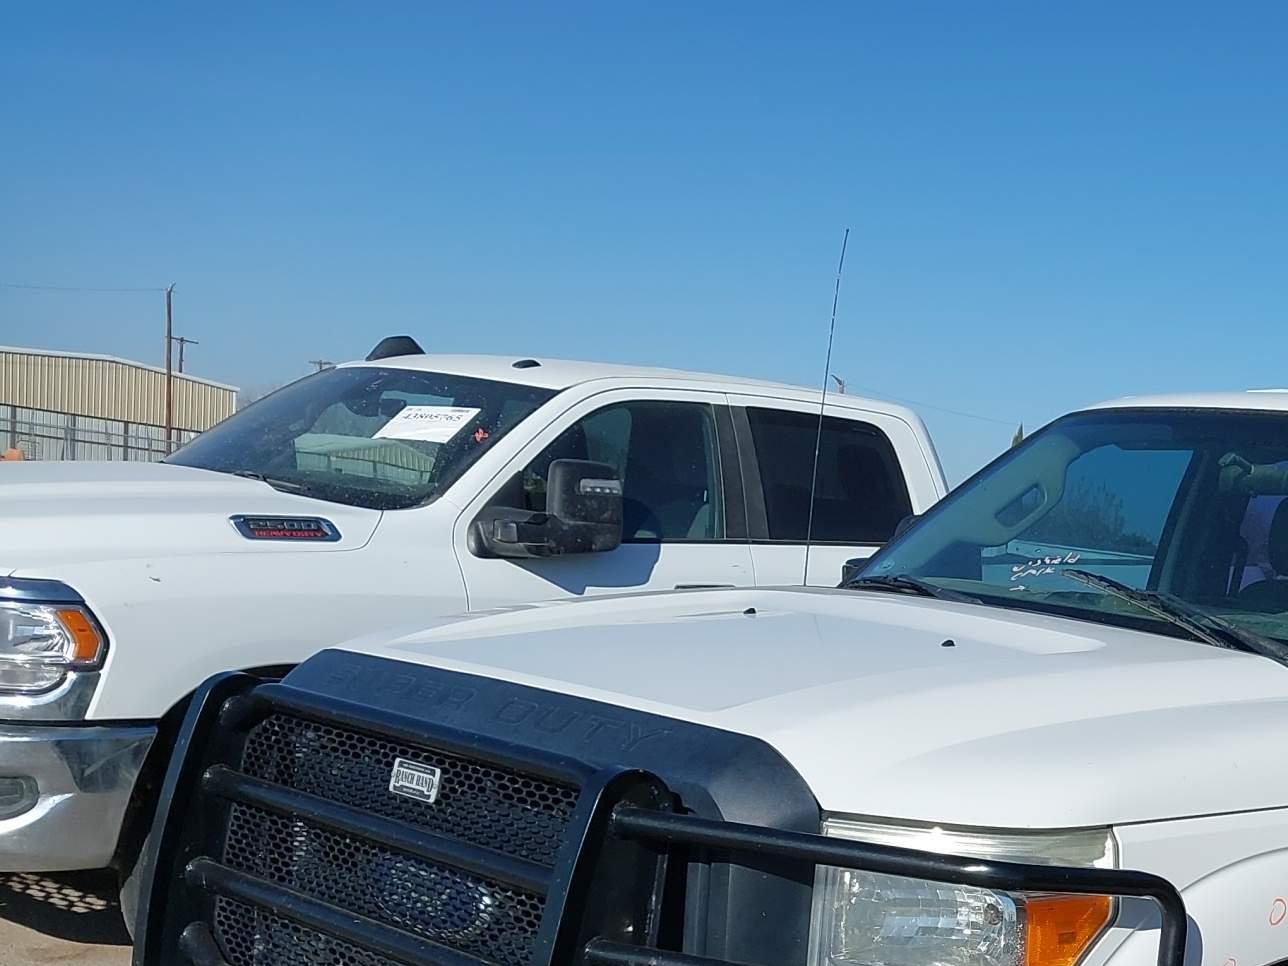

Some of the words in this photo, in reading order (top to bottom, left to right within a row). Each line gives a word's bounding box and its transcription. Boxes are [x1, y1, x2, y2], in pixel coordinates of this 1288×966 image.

[248, 519, 318, 530] 2500
[329, 664, 479, 713] SUPER
[499, 698, 674, 751] DUTY
[393, 768, 416, 786] RANCH
[415, 774, 435, 793] HAND
